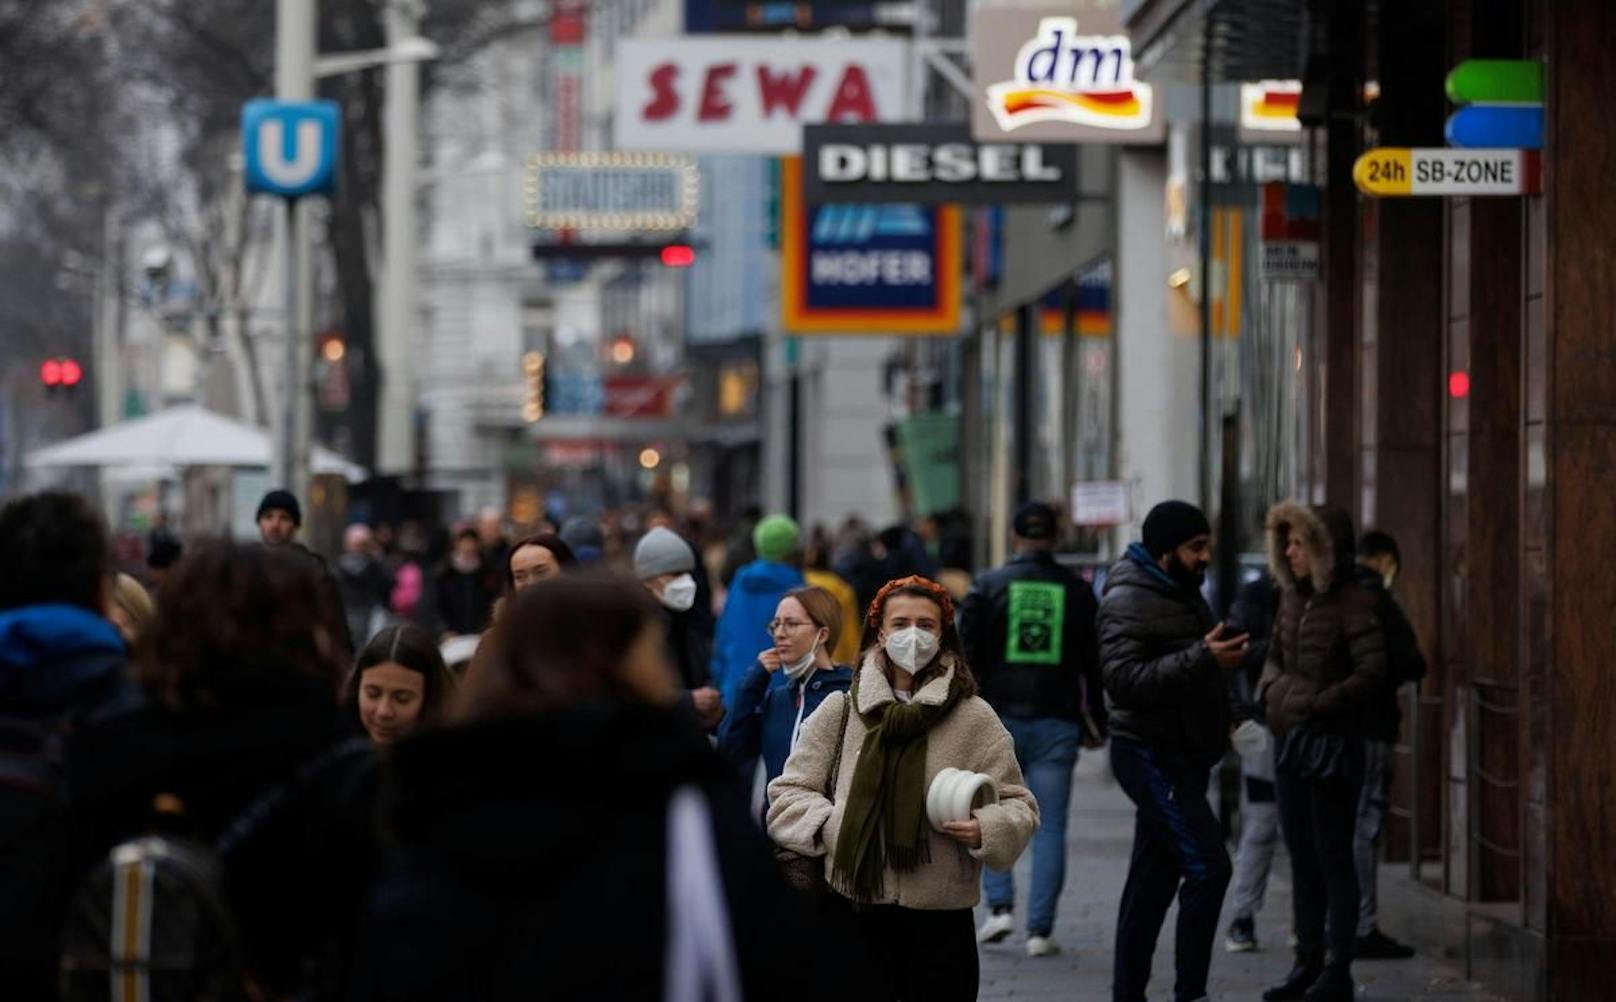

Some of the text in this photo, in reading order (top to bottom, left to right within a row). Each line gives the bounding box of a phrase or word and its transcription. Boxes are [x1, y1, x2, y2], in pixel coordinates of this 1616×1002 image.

[1028, 30, 1122, 82] dm
[641, 61, 880, 123] SEWA
[259, 119, 322, 188] U
[818, 144, 1062, 182] DIESEL
[1368, 159, 1513, 183] 24h SB-ZONE
[811, 251, 933, 285] HOFER
